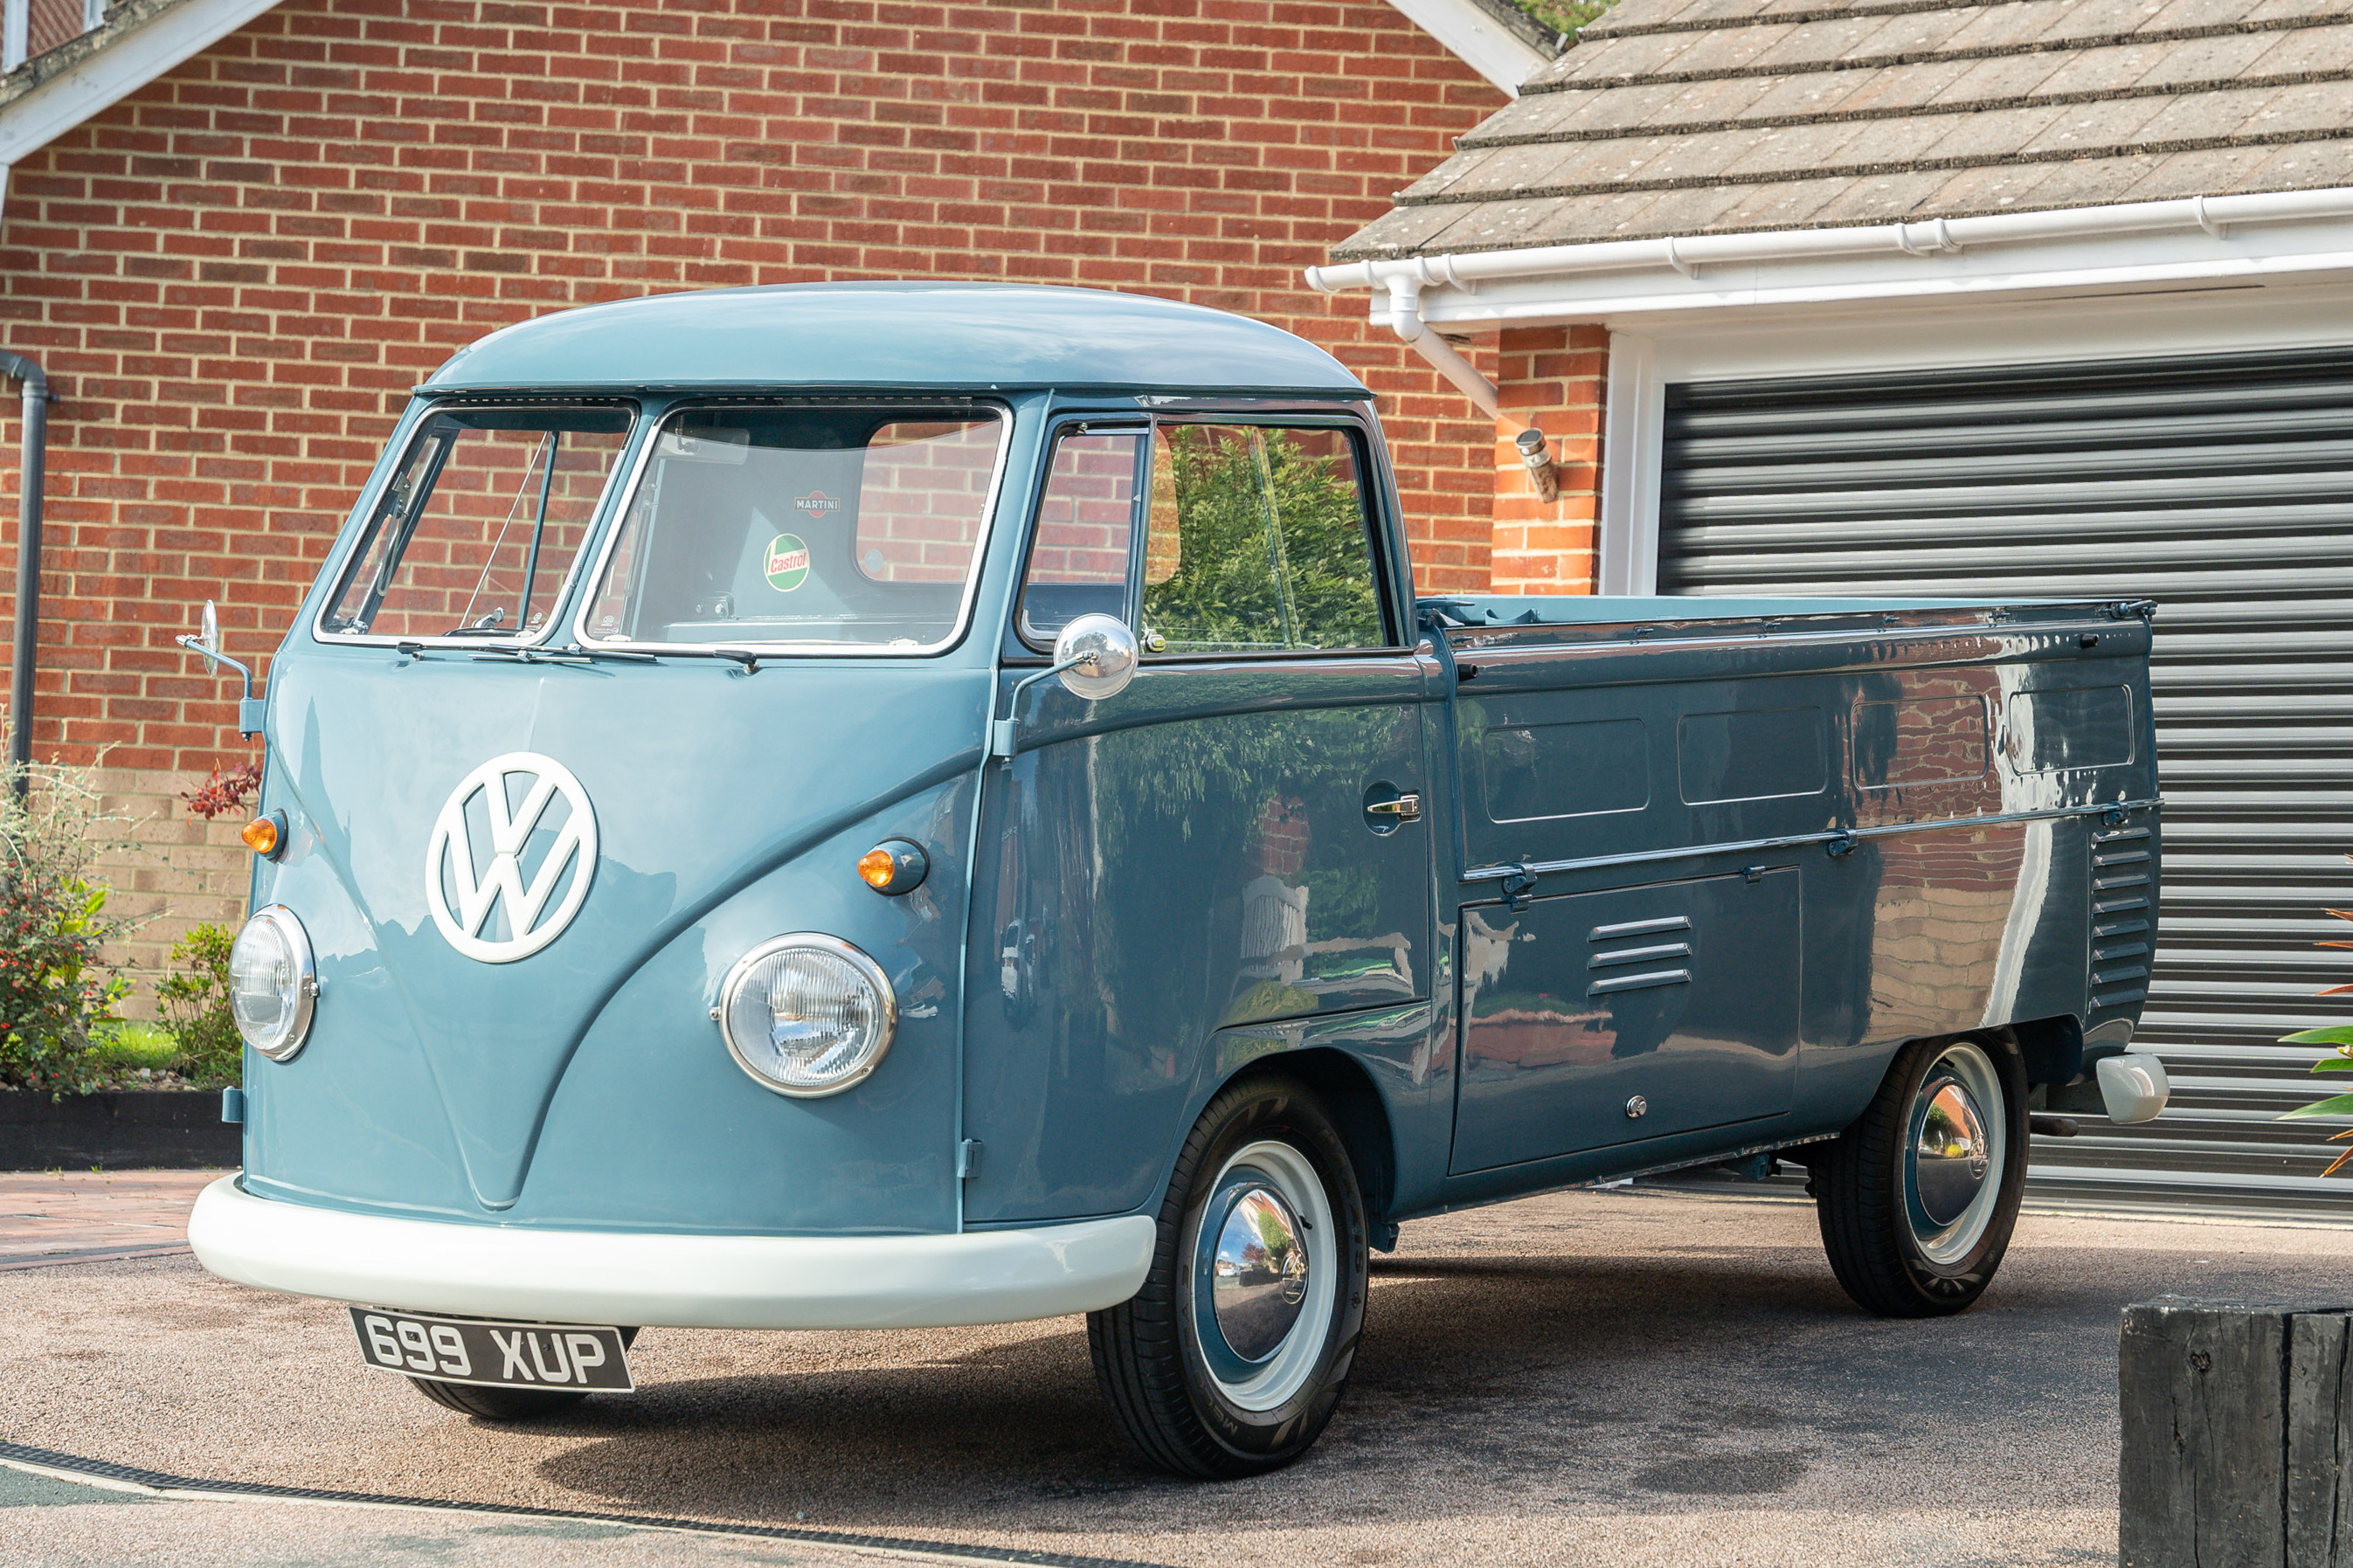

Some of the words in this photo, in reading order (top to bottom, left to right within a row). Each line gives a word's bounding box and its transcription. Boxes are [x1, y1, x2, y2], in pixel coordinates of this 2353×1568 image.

[796, 500, 838, 509] MARTINI
[770, 552, 806, 573] Castrol
[363, 1315, 472, 1377] 699
[489, 1330, 606, 1385] XUP
